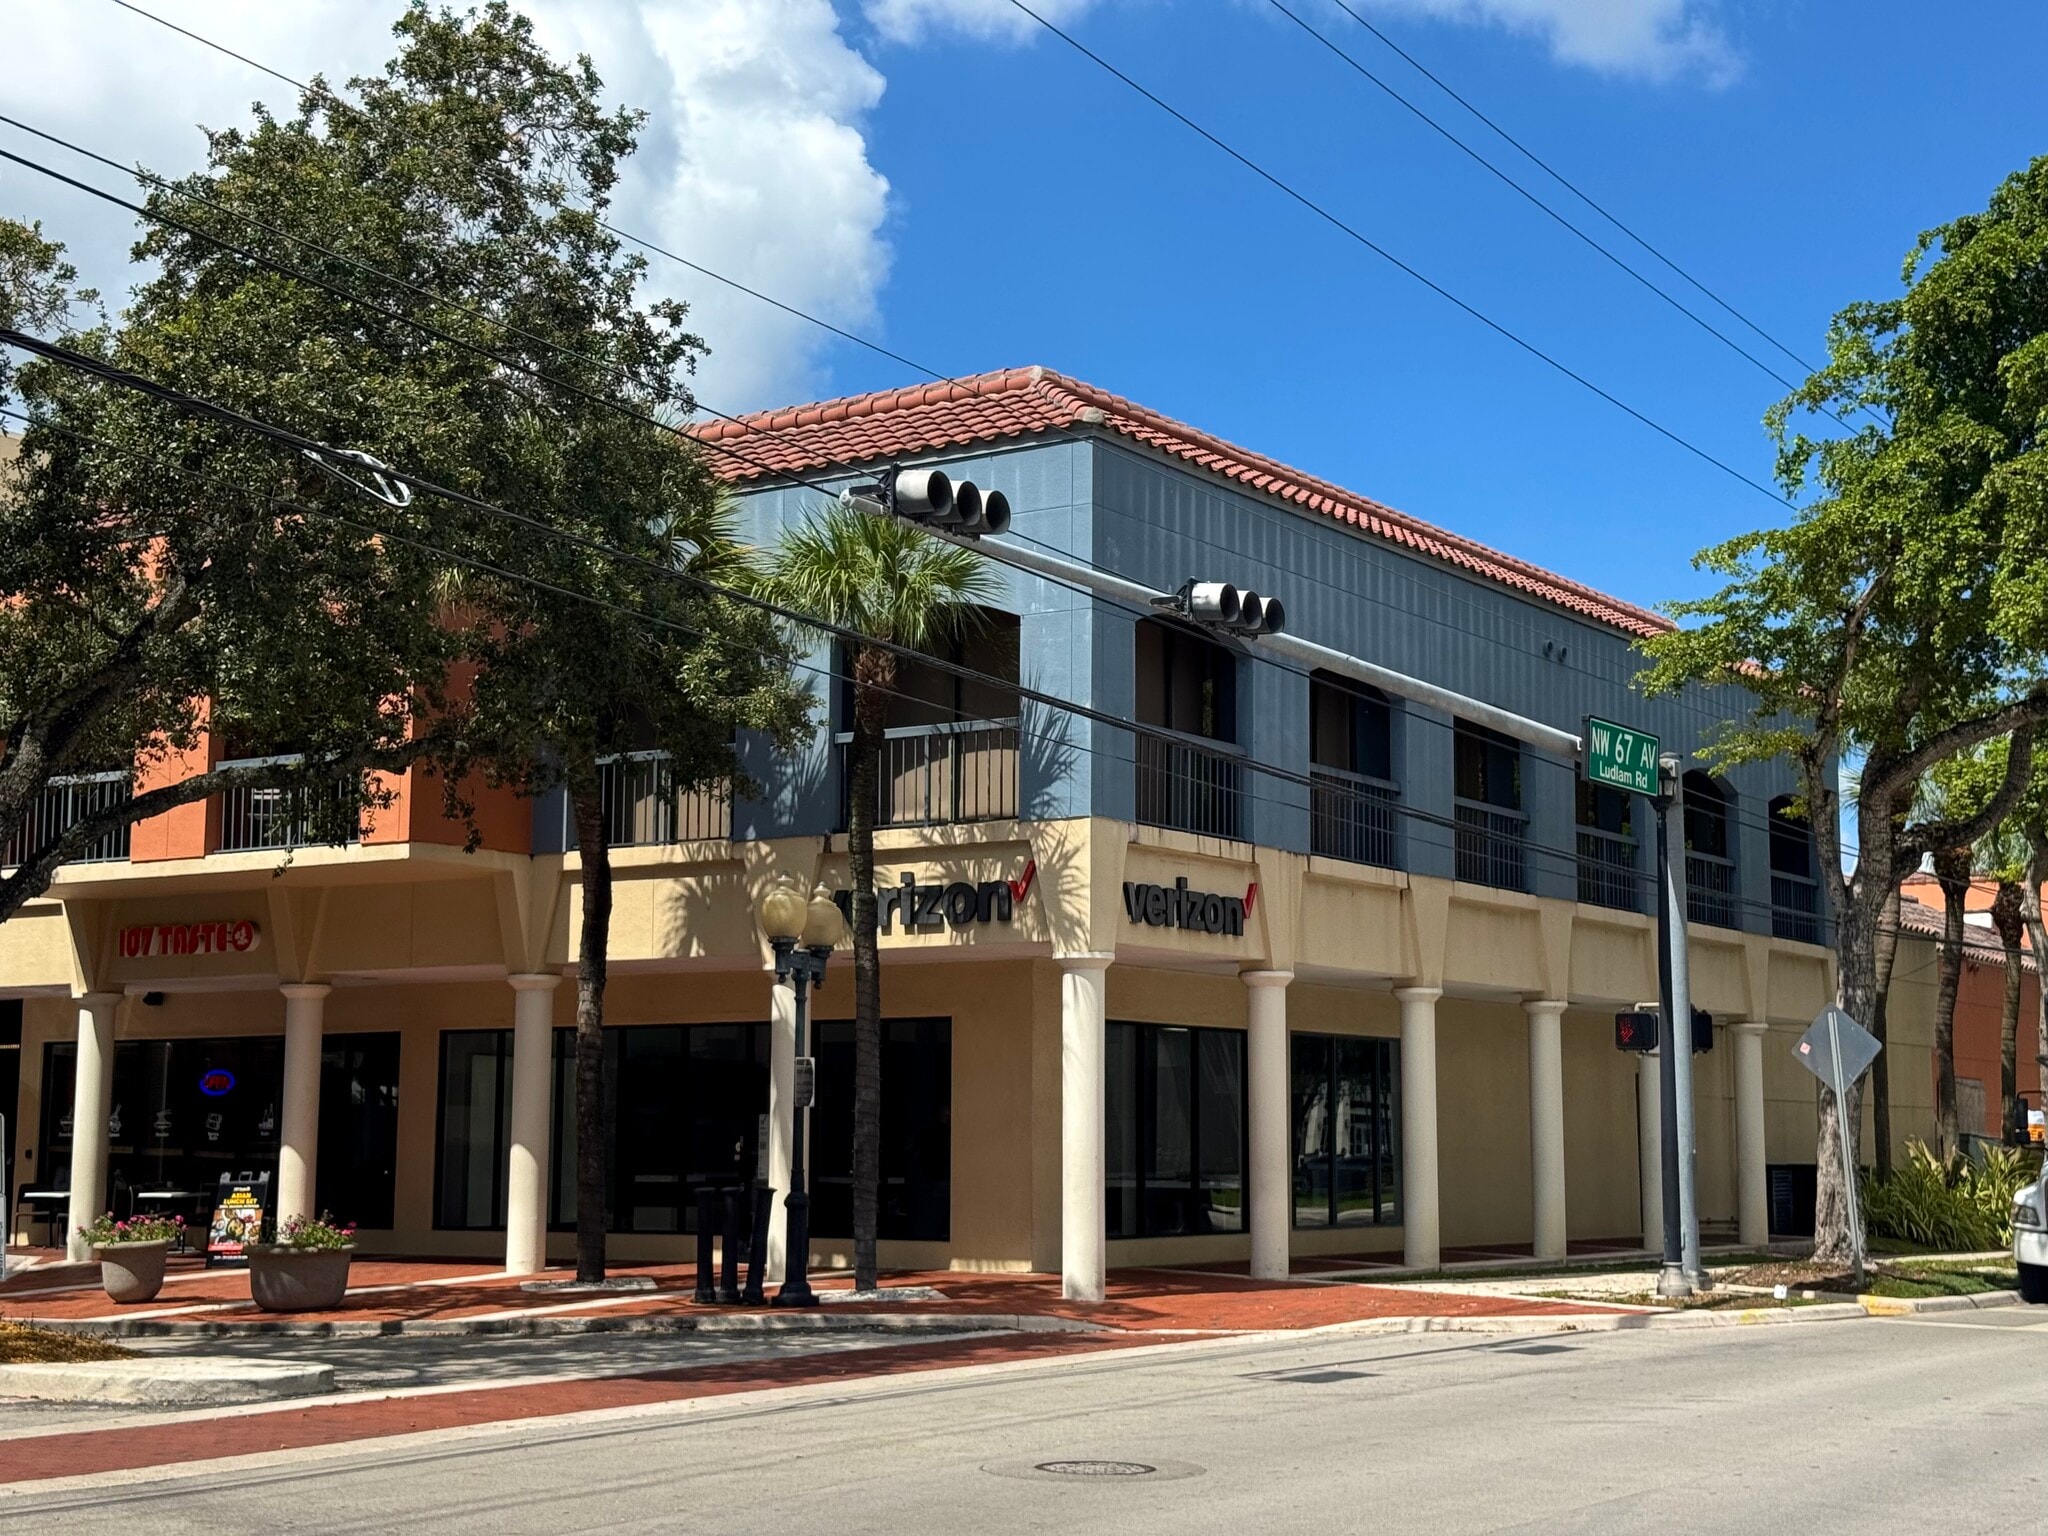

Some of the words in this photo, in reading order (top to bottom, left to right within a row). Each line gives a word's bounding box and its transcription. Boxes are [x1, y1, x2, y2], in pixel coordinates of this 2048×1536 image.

[1592, 727, 1610, 757] NW
[1615, 733, 1633, 765] 67
[1640, 742, 1656, 769] AV
[1600, 761, 1632, 784] Ludlam
[1635, 771, 1648, 788] Rd
[1123, 877, 1243, 936] verizon
